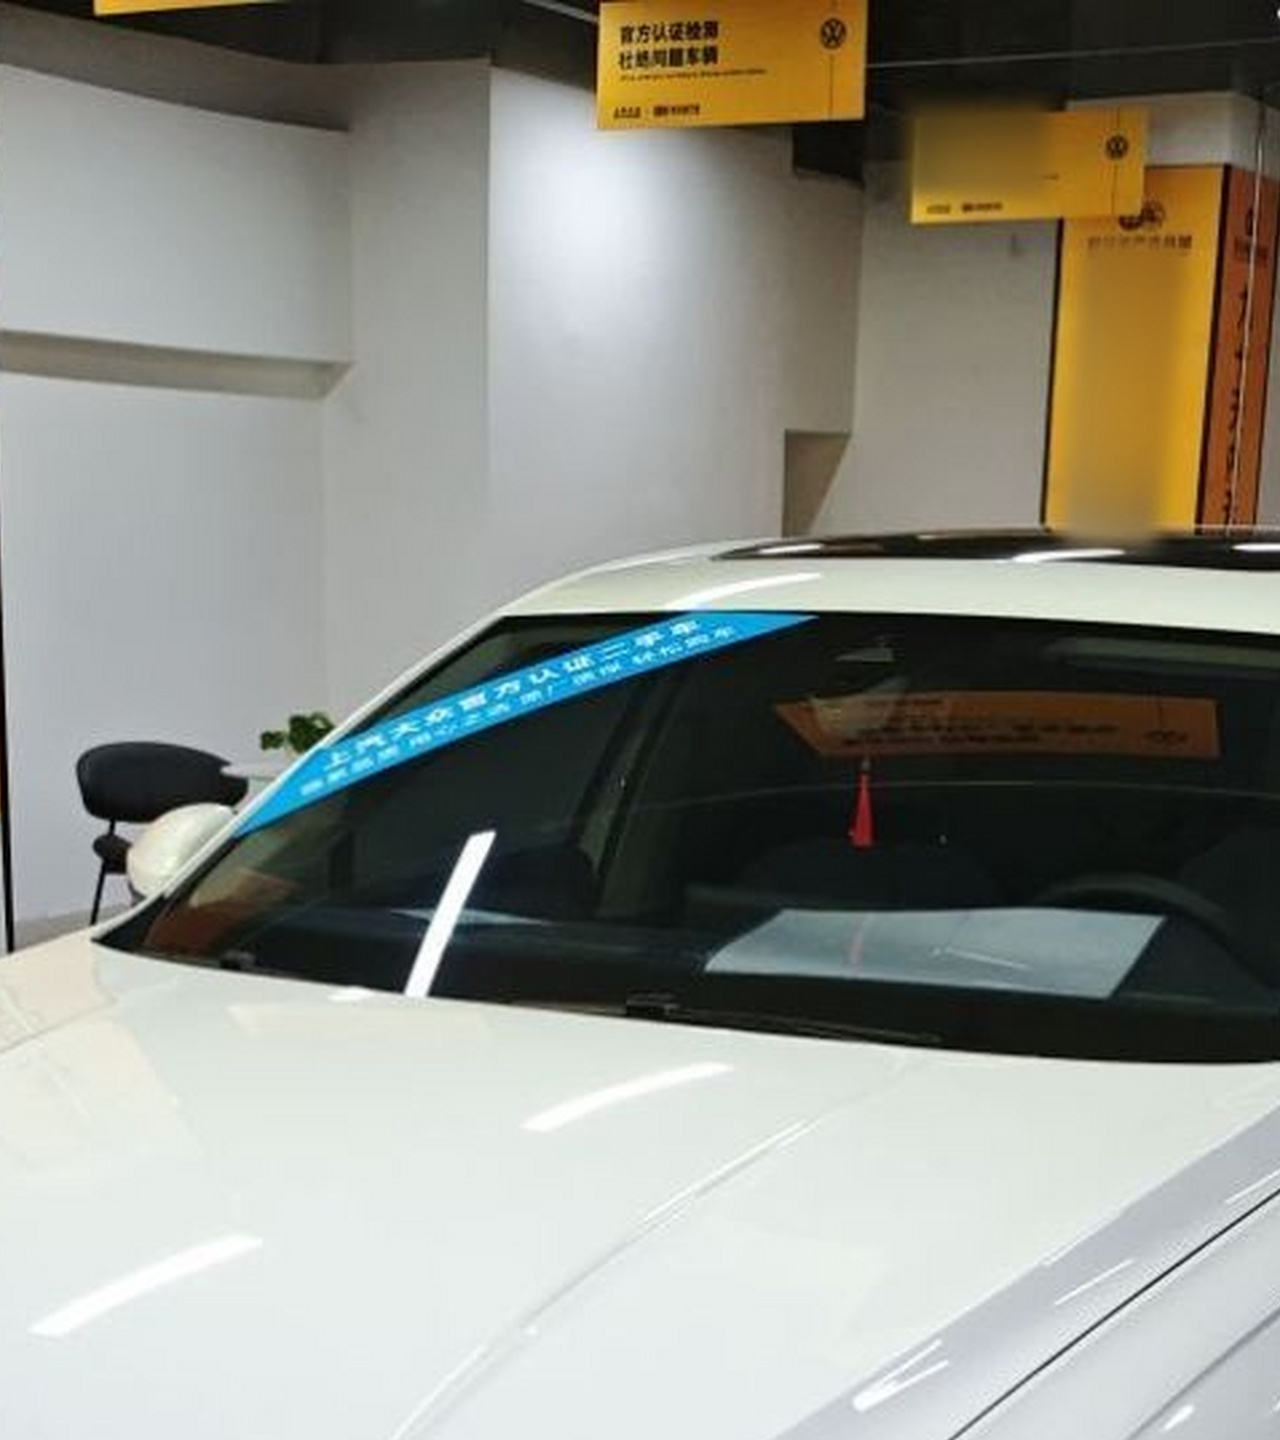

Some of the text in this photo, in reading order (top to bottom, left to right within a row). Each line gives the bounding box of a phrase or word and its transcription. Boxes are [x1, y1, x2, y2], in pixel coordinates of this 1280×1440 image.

[621, 20, 719, 44] 官方认证检测
[618, 45, 718, 69] 杜绝问题车辆
